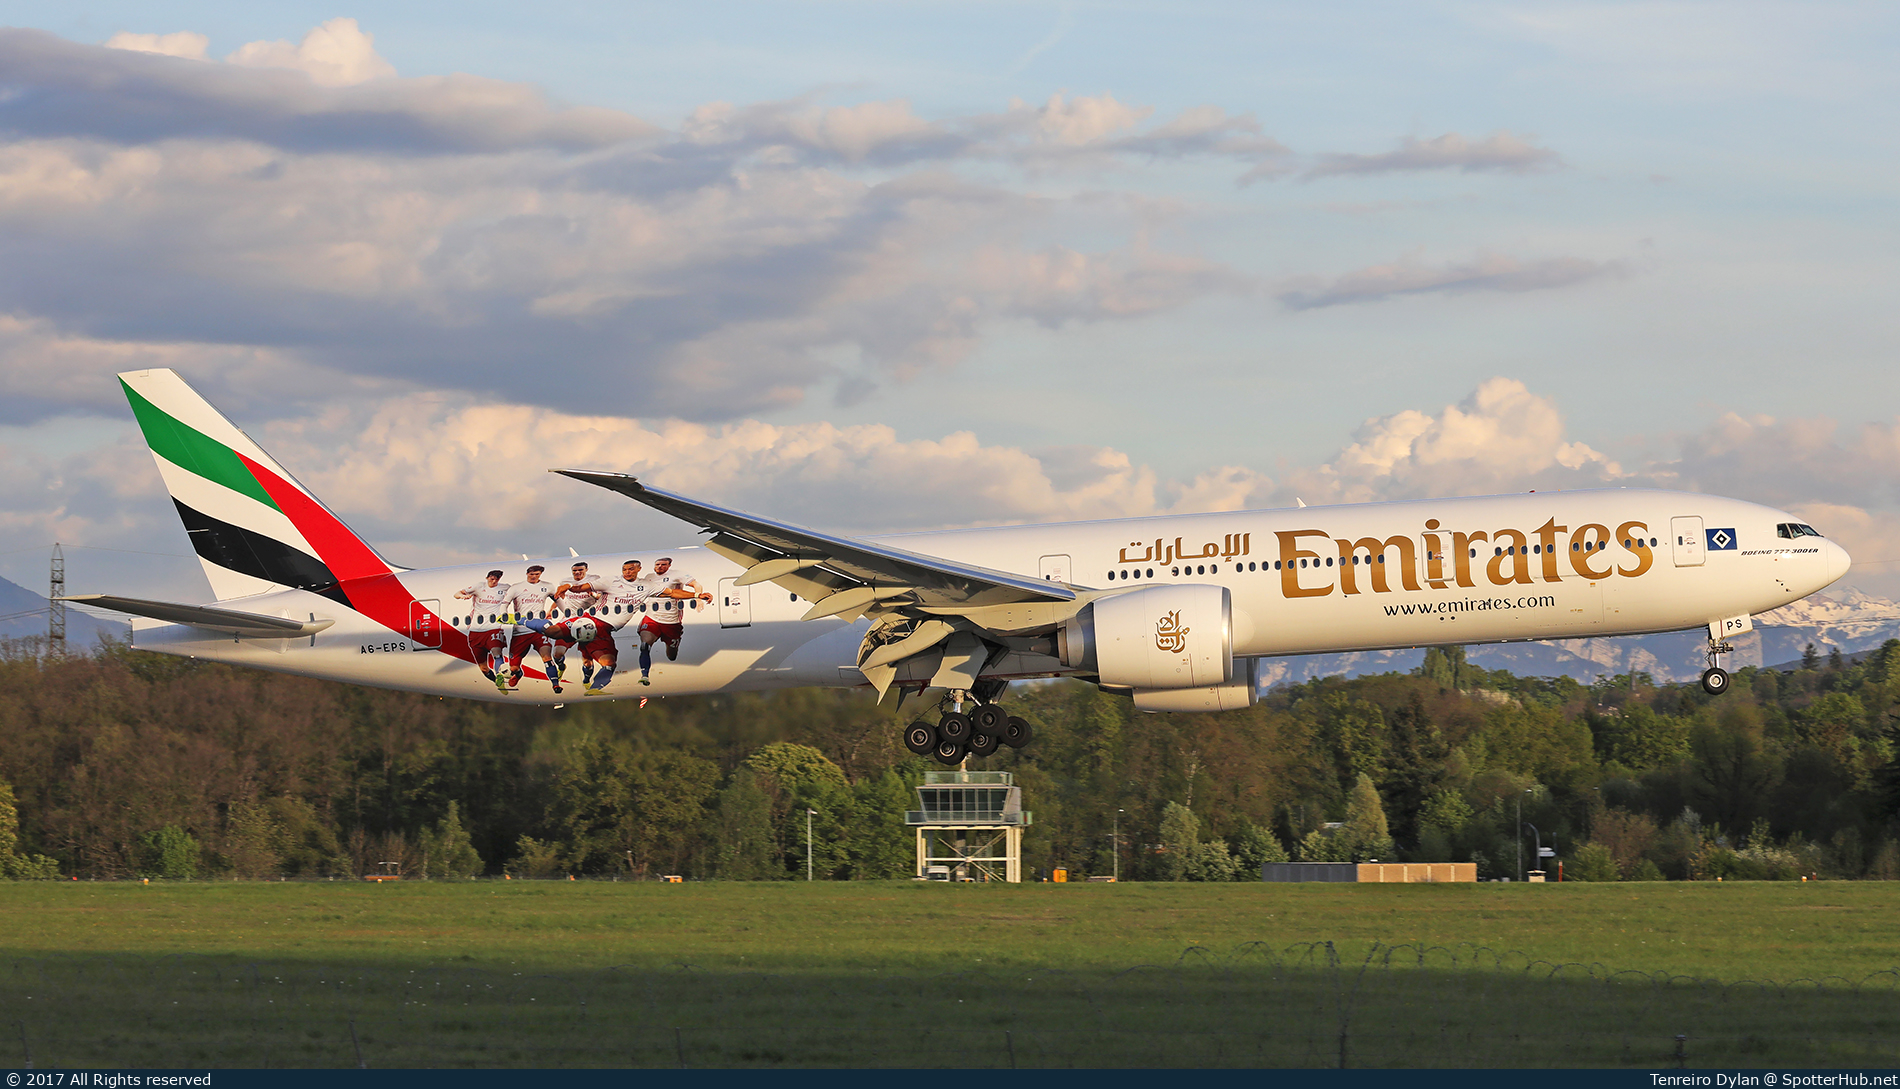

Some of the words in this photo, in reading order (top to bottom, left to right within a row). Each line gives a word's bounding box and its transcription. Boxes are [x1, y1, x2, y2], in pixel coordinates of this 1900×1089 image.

[1118, 532, 1251, 566] الإمارات
[1273, 516, 1655, 599] Emirates
[1383, 594, 1556, 616] www.emirates.com
[1727, 618, 1743, 631] PS
[360, 641, 406, 655] A6-EPS
